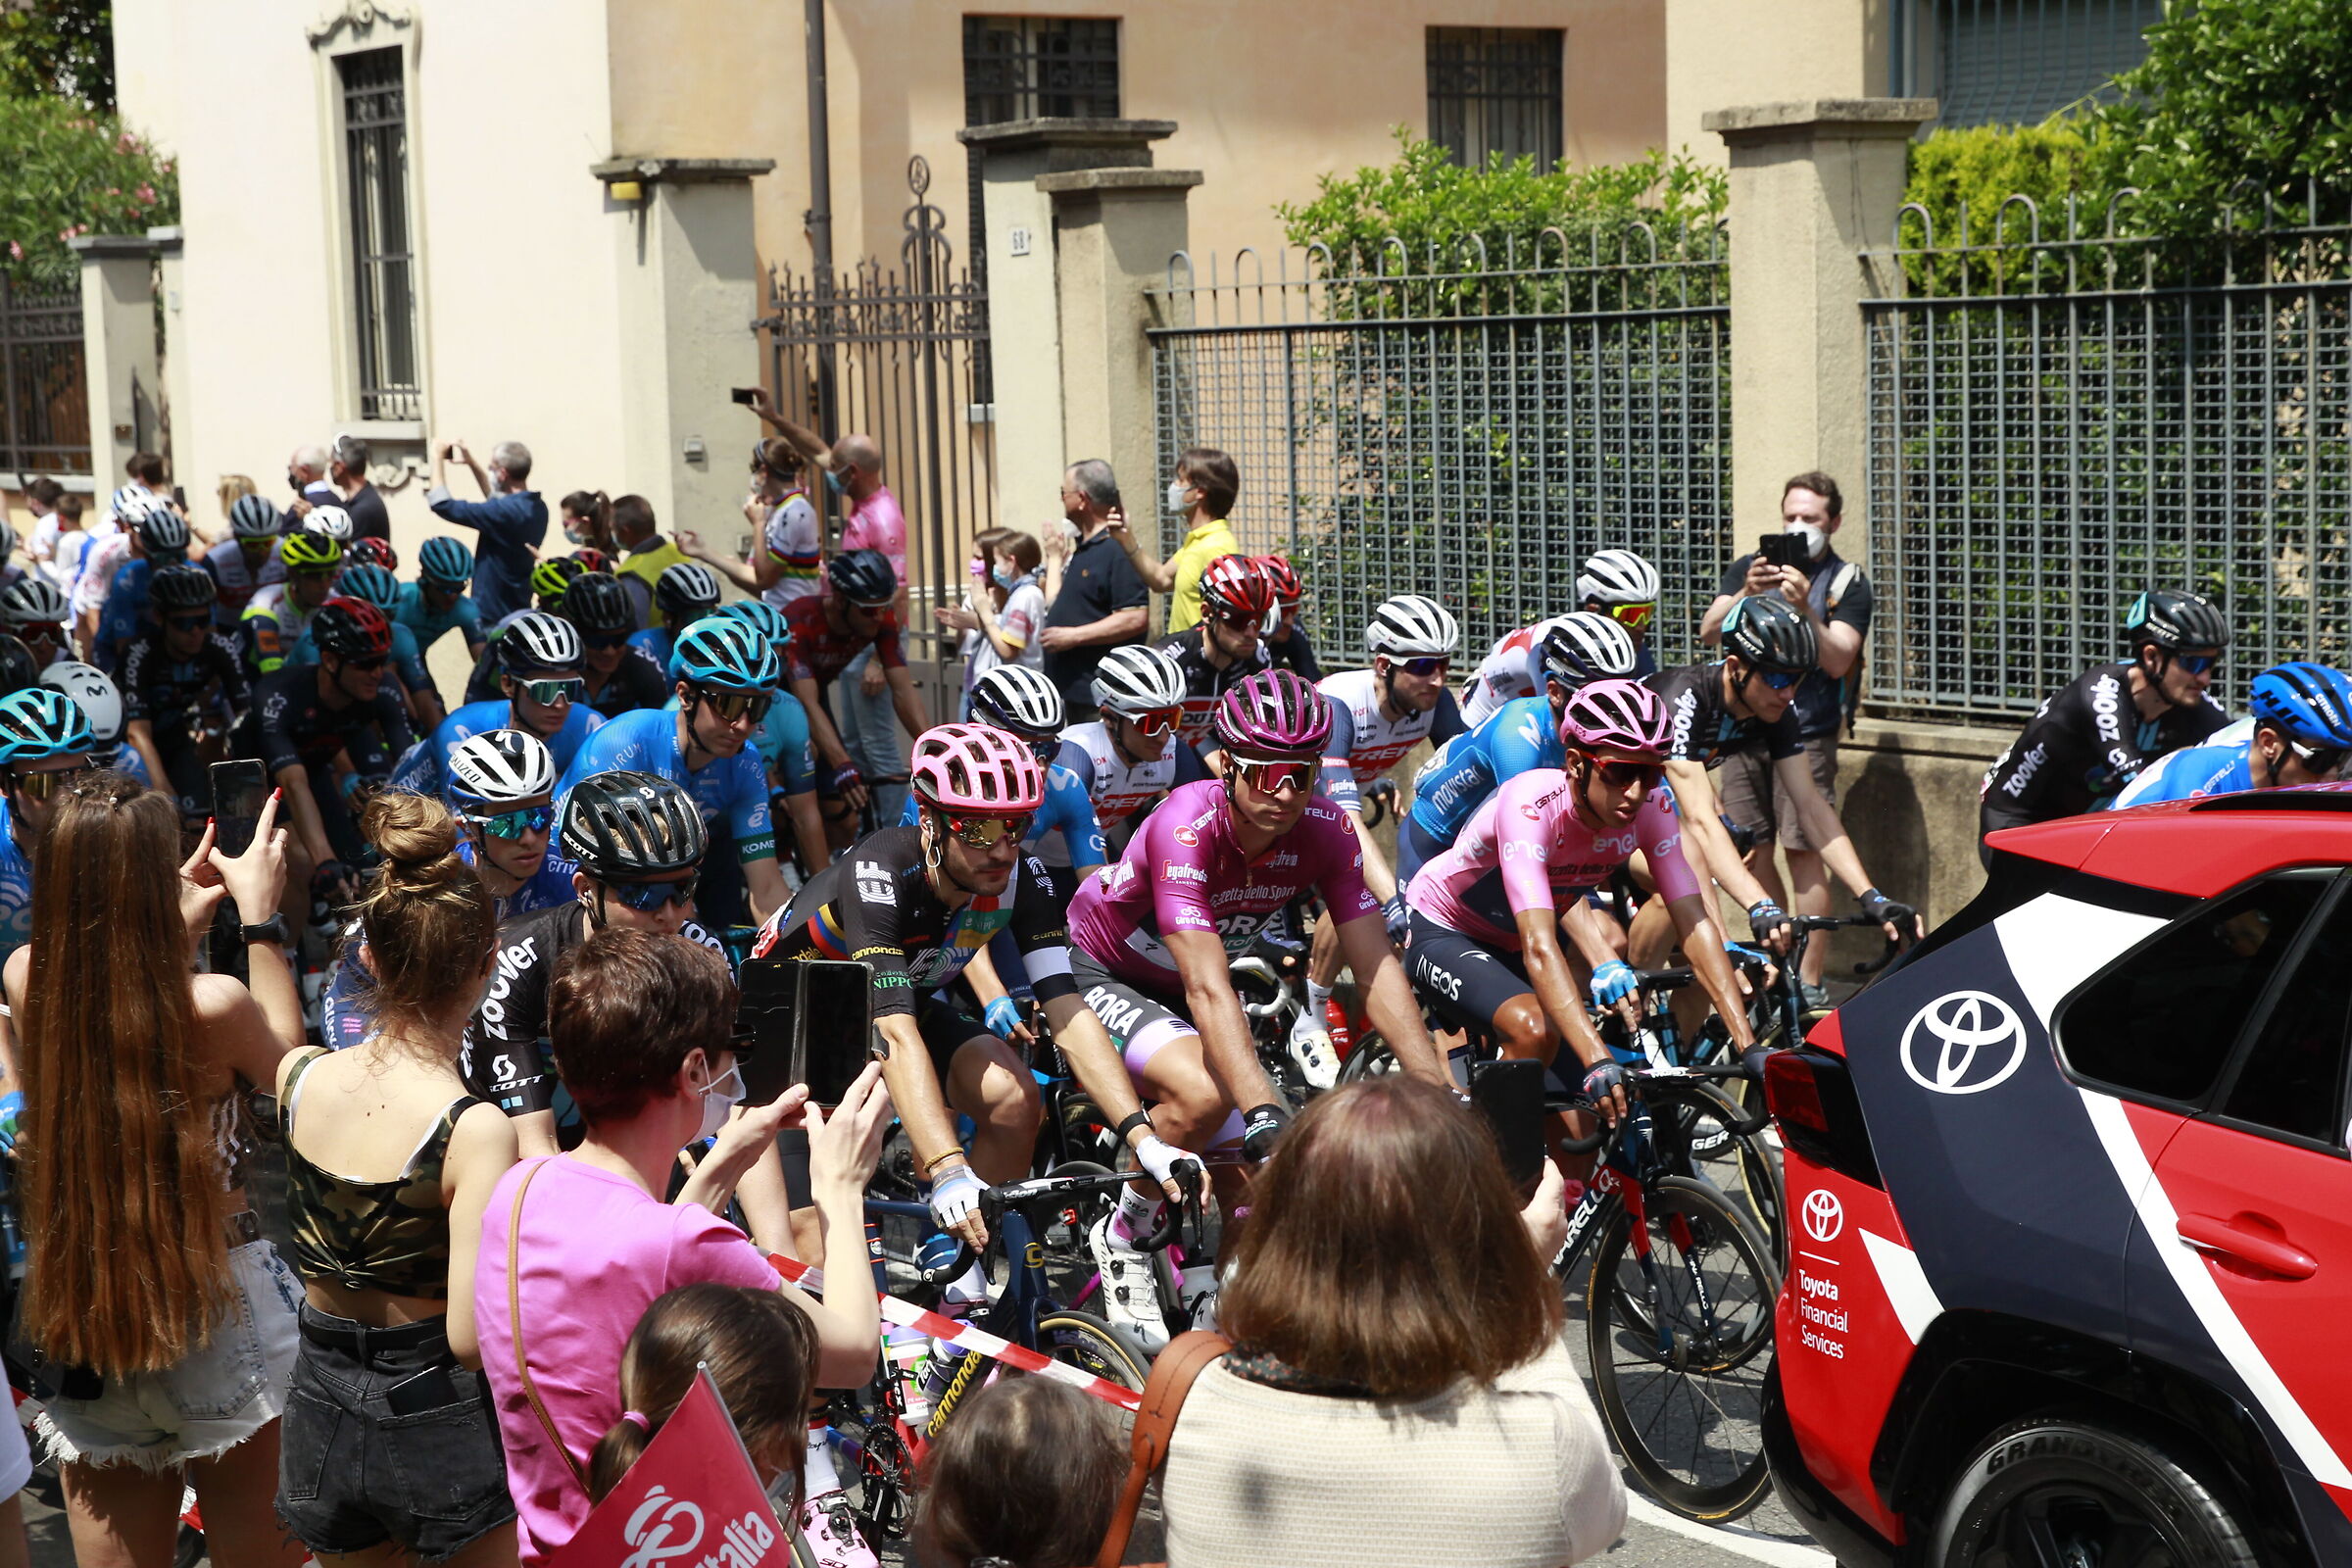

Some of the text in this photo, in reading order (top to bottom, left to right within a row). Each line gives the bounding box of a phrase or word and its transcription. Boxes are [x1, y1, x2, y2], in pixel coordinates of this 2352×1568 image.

[2089, 673, 2121, 743] zoover
[2257, 689, 2313, 728] HJC
[2314, 692, 2342, 728] CITROËN
[1574, 724, 1588, 737] EOS
[2001, 742, 2049, 799] zoover
[1432, 767, 1486, 815] movistar
[562, 831, 599, 861] SCOTT
[741, 841, 775, 857] KOME
[1592, 826, 1639, 857] enel
[1652, 832, 1682, 858] en
[1159, 858, 1209, 883] Segafredo
[1244, 886, 1269, 903] dello
[1269, 885, 1298, 902] Sport
[481, 936, 539, 1042] zoover
[1415, 954, 1463, 1002] INEOS
[1084, 985, 1144, 1037] BORA
[1690, 1130, 1731, 1151] GER
[1547, 1167, 1614, 1278] NARELLO
[1798, 1268, 1838, 1301] Toyota
[1800, 1297, 1849, 1334] Financial
[1801, 1324, 1844, 1359] Services
[927, 1347, 983, 1439] cannonda
